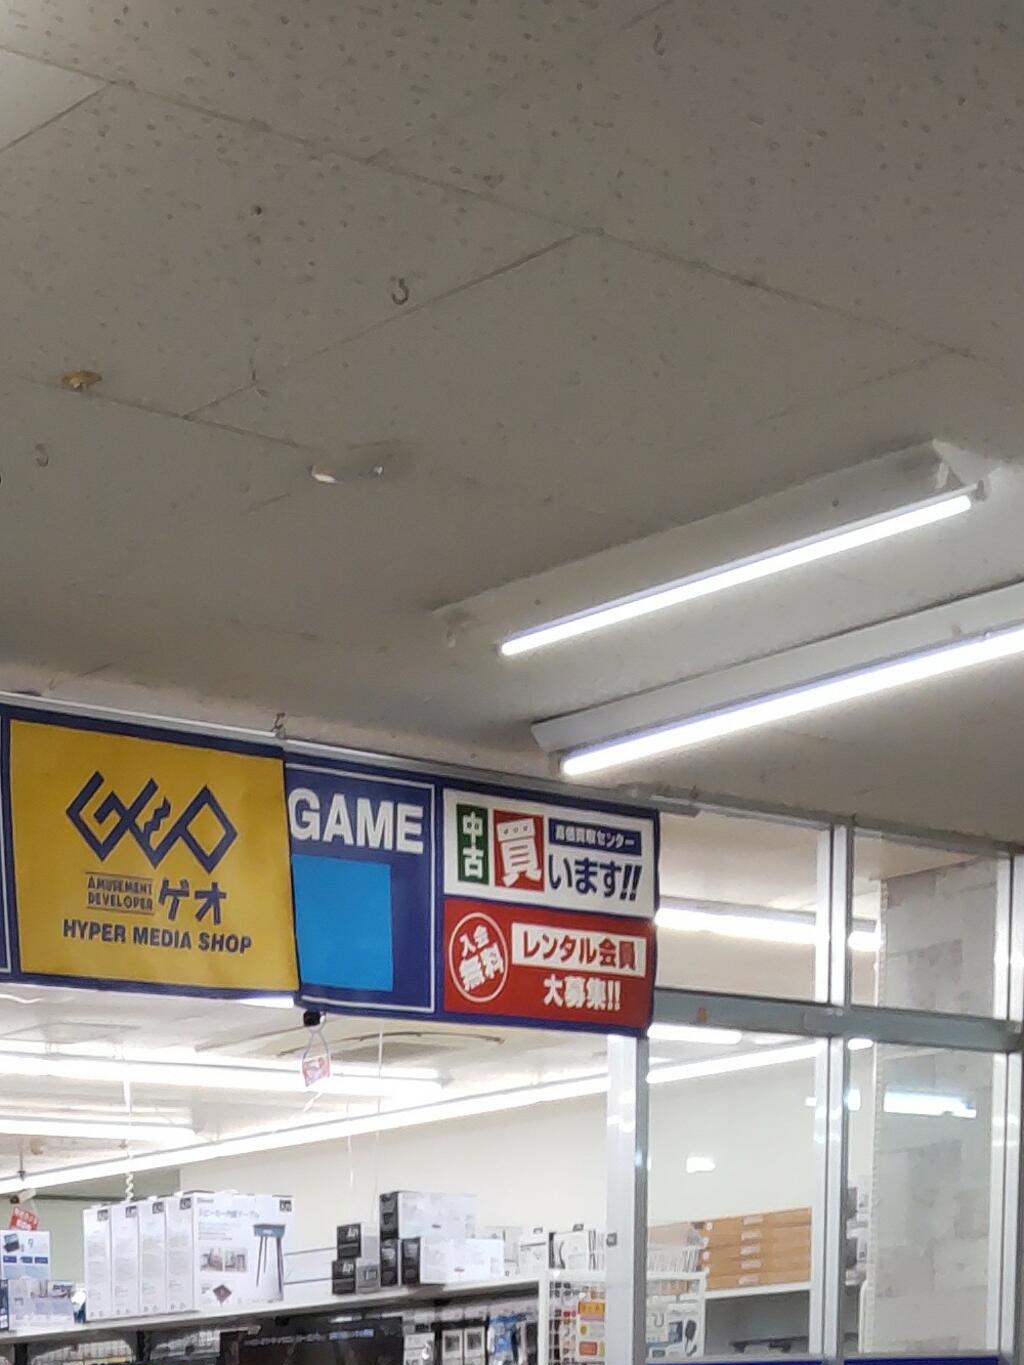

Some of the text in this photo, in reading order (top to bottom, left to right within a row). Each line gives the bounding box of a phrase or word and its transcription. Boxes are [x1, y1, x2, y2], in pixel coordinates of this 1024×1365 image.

[65, 770, 238, 874] GEO
[288, 788, 424, 854] GAME
[462, 811, 484, 879] 中古
[88, 876, 152, 894] AMUSEMENT
[88, 892, 153, 910] DEVELOPER
[158, 878, 226, 925] ゲオ
[63, 919, 251, 954] HYPER MEDIA SHOP
[459, 924, 489, 957] 入会
[523, 930, 636, 970] レンタル会員
[459, 943, 504, 991] 無料
[543, 973, 621, 1011] 大募集!!
